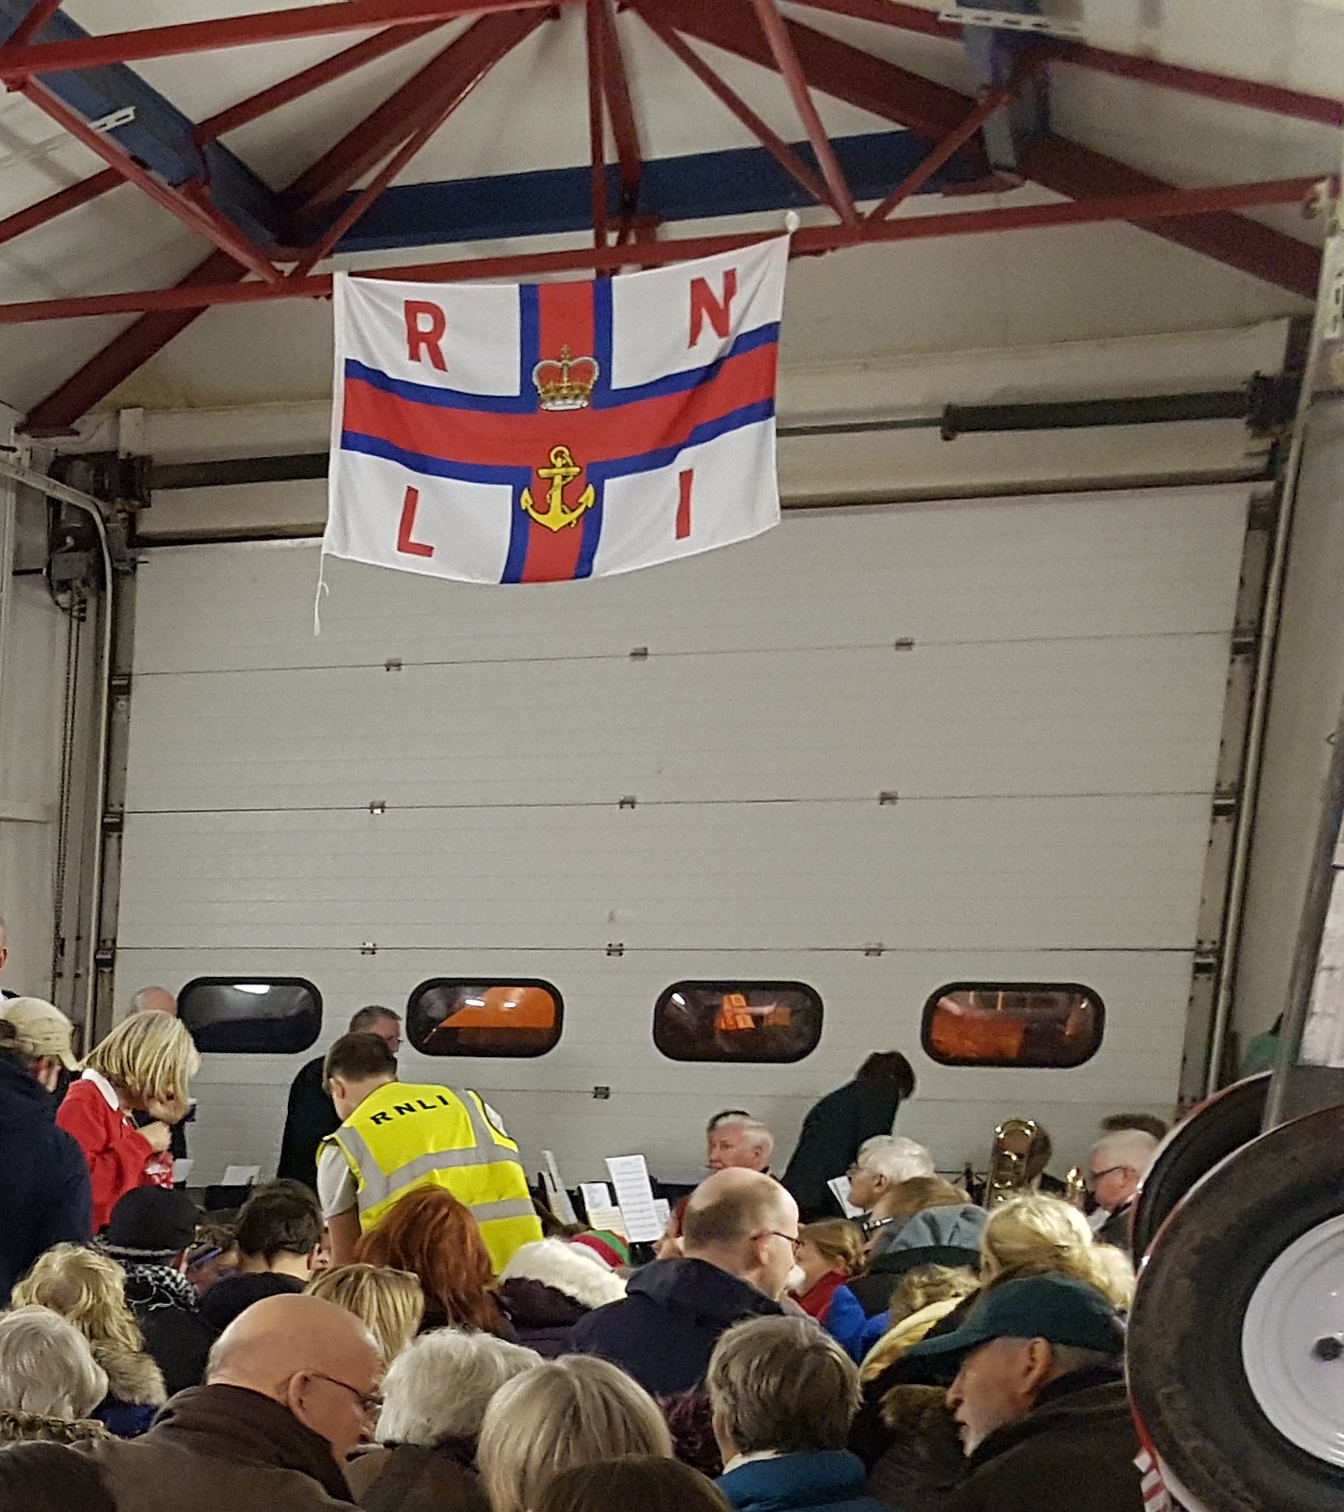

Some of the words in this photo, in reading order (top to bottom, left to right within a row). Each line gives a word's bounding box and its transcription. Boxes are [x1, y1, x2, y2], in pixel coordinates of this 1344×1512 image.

[404, 300, 448, 372] R
[688, 268, 737, 349] N
[397, 486, 434, 558] L
[676, 469, 693, 540] I
[369, 1094, 450, 1126] RNLI
